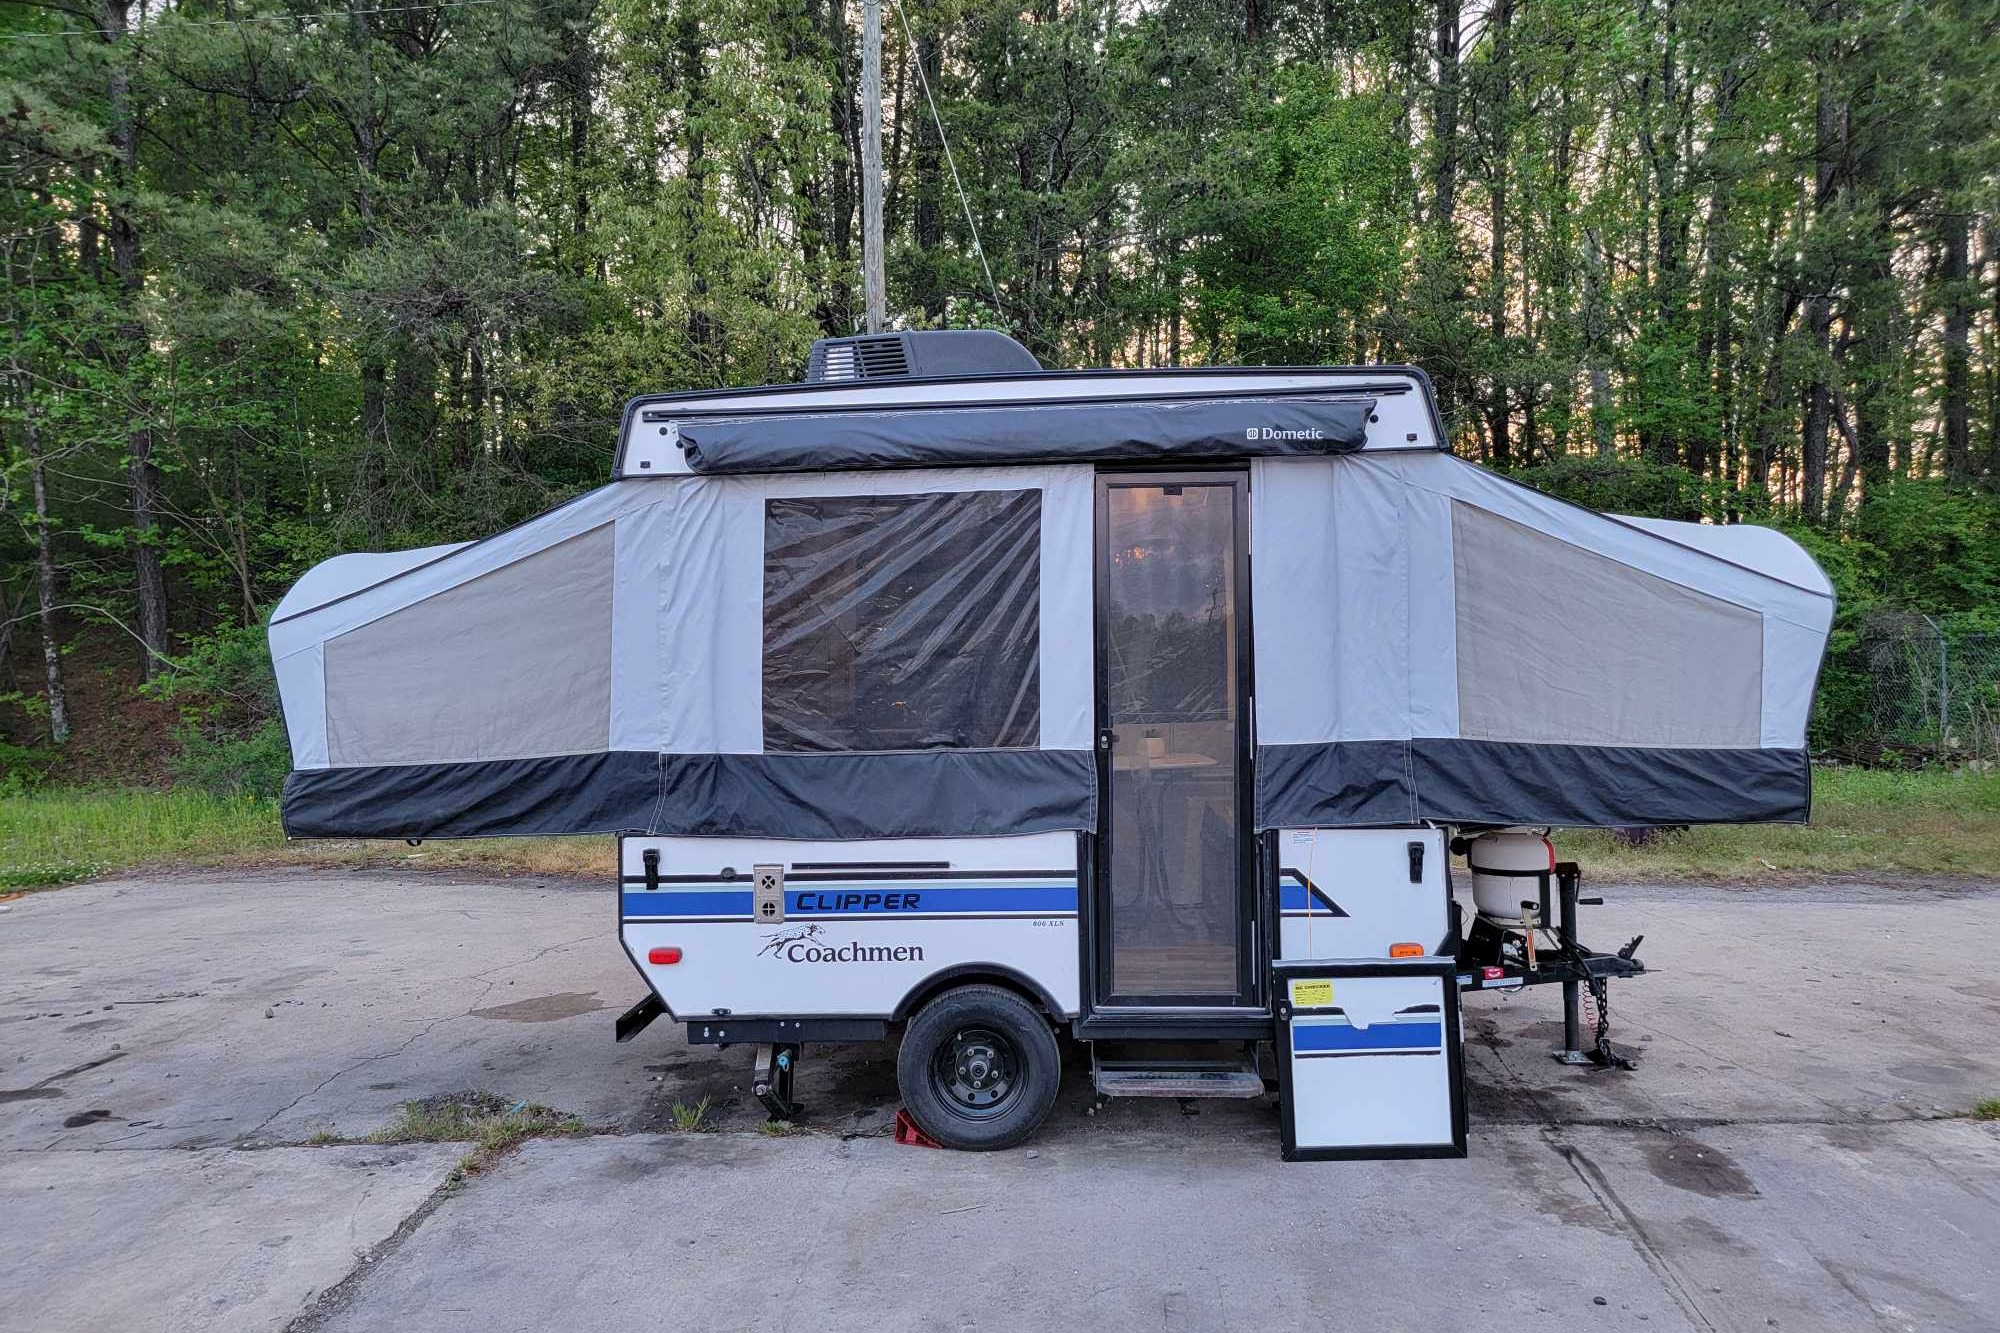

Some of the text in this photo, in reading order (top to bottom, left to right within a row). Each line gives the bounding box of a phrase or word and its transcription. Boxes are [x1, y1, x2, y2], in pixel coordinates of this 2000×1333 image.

[1262, 427, 1324, 440] Dometic
[796, 893, 921, 910] CLIPPER
[787, 941, 924, 963] Coachmen
